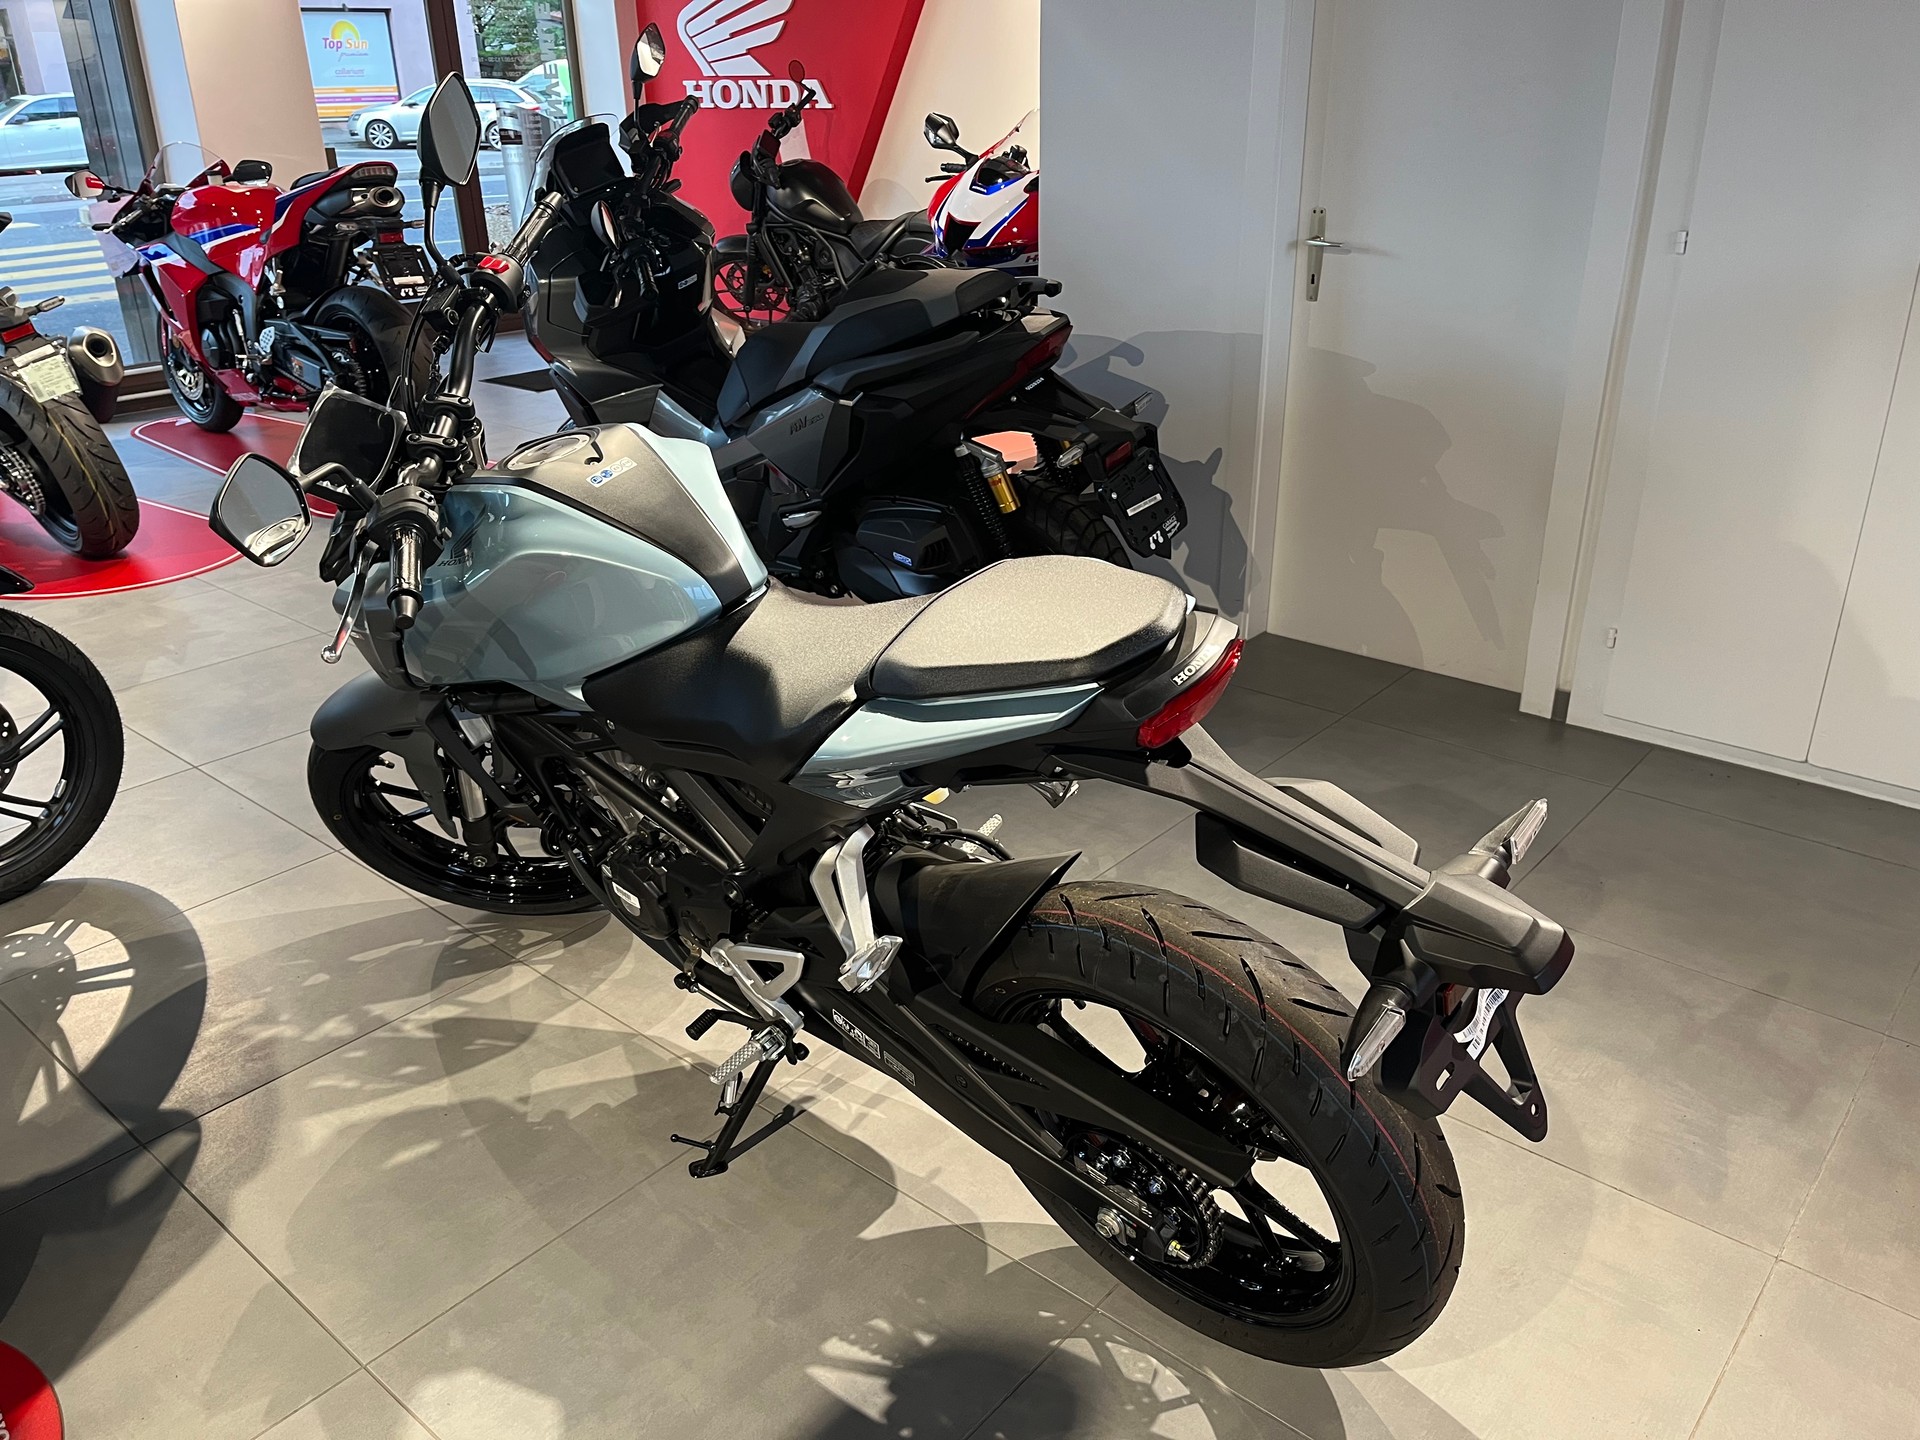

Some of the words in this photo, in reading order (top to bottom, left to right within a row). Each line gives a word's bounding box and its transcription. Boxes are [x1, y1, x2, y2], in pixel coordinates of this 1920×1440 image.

[322, 37, 343, 52] Top
[345, 38, 368, 50] Sun
[682, 79, 834, 109] HONDA
[1172, 643, 1222, 686] HONDA
